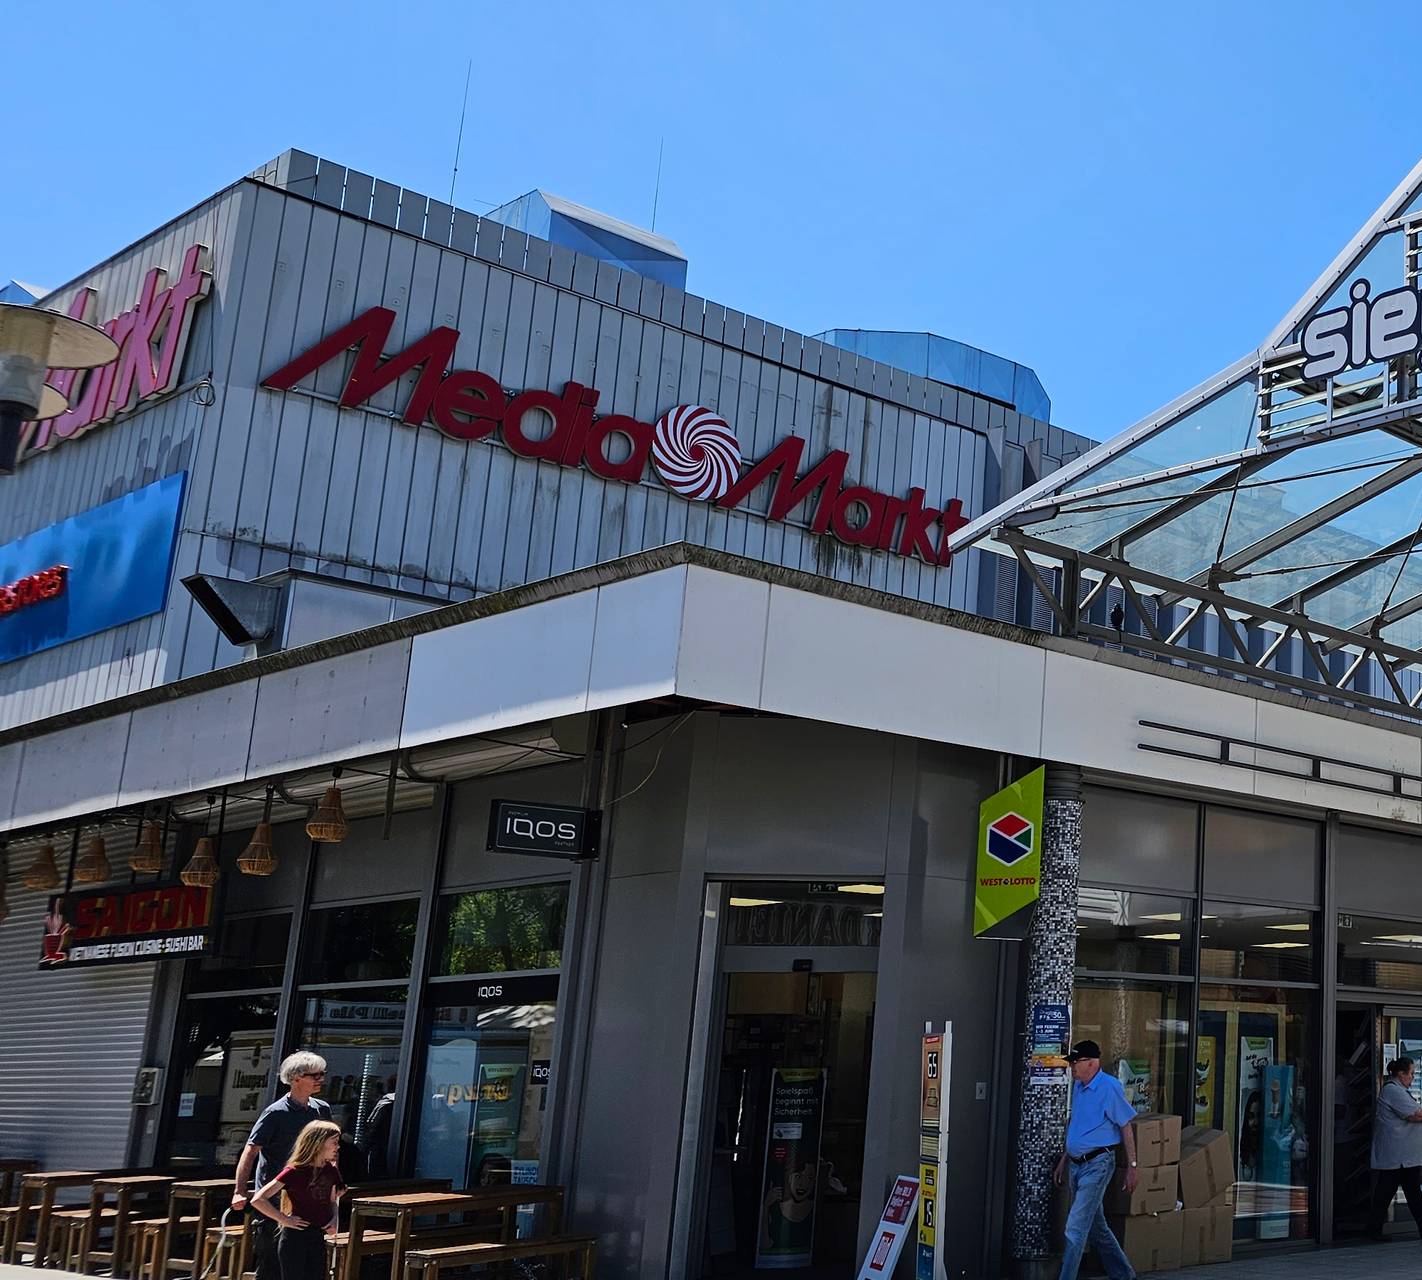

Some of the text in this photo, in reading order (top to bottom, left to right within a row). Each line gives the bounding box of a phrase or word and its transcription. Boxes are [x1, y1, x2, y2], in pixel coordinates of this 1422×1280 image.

[15, 243, 213, 464] arkt
[260, 305, 971, 569] Media Markt
[505, 817, 576, 840] IQOS
[980, 877, 1036, 886] WEST LOTTO
[74, 886, 212, 940] SAIGON
[165, 936, 188, 953] SUSHI
[188, 935, 205, 951] BAR
[477, 985, 503, 999] IQOS
